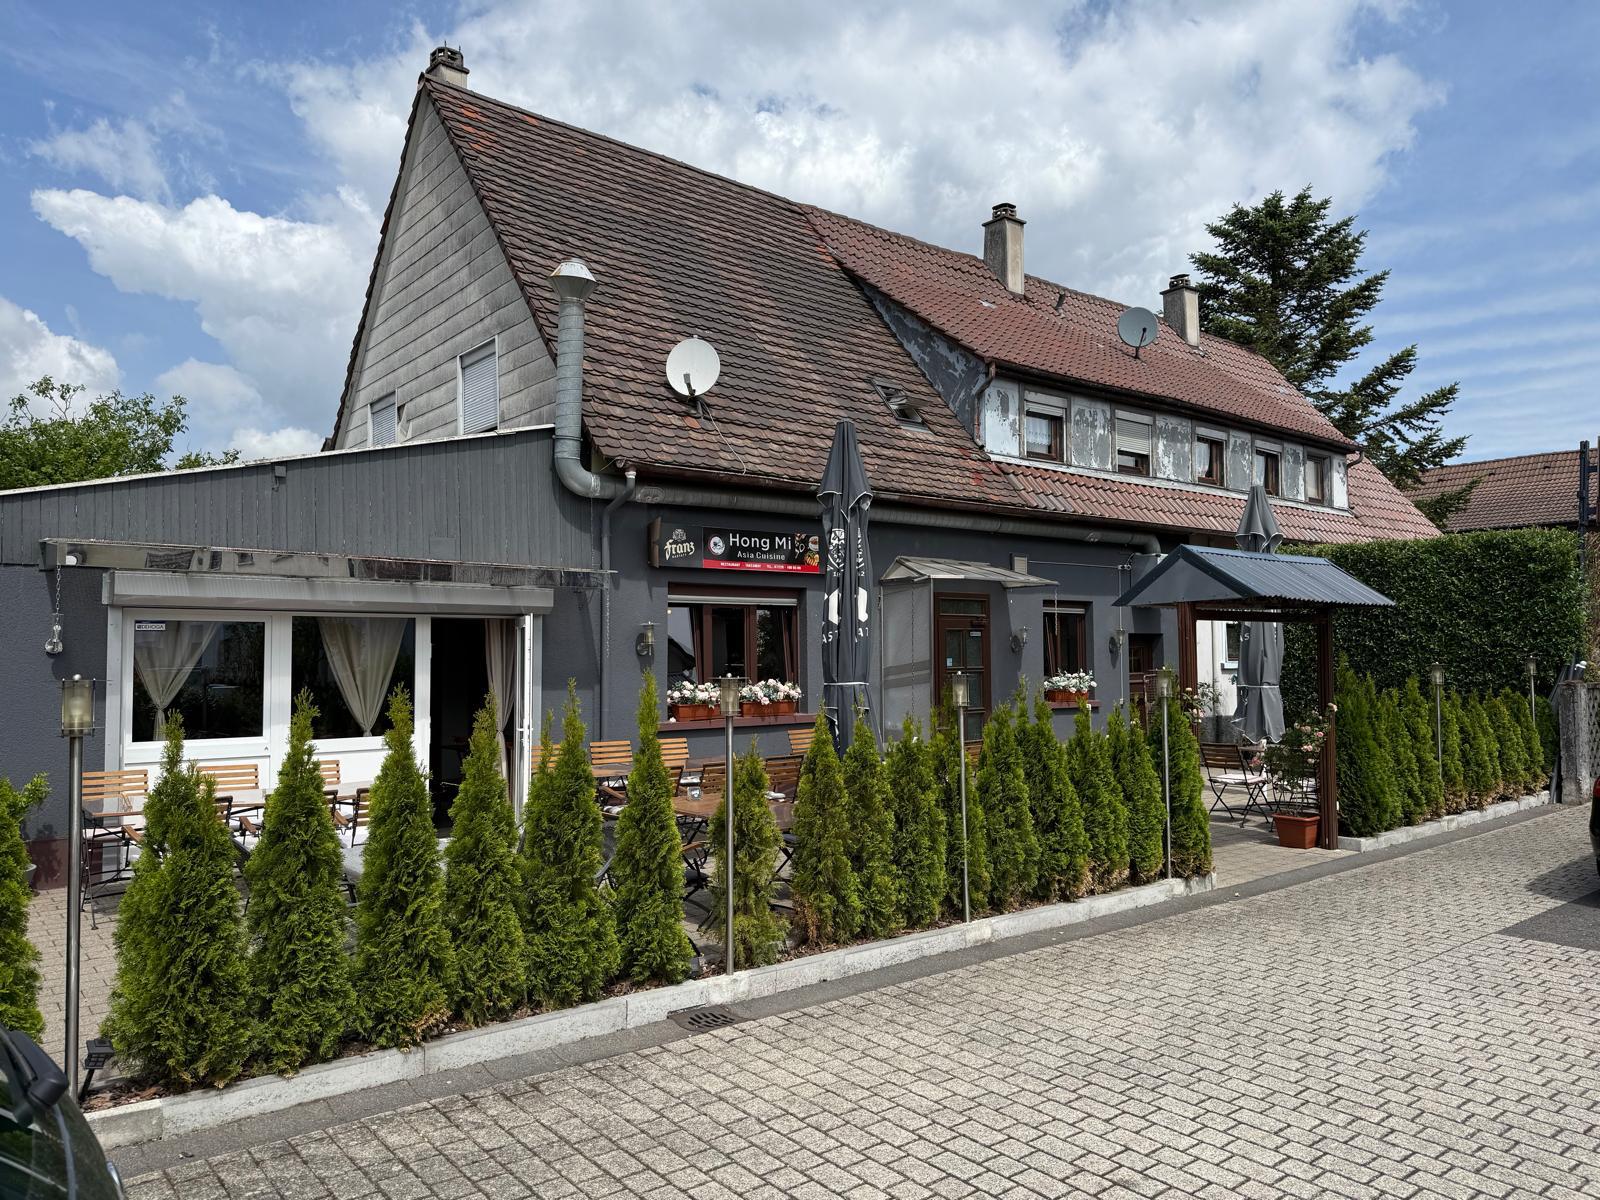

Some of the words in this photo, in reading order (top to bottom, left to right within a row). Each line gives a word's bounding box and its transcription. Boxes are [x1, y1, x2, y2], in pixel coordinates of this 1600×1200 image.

[729, 533, 770, 551] Hong
[775, 536, 792, 550] Mi
[737, 550, 755, 559] Asia
[756, 551, 786, 561] Cuisine
